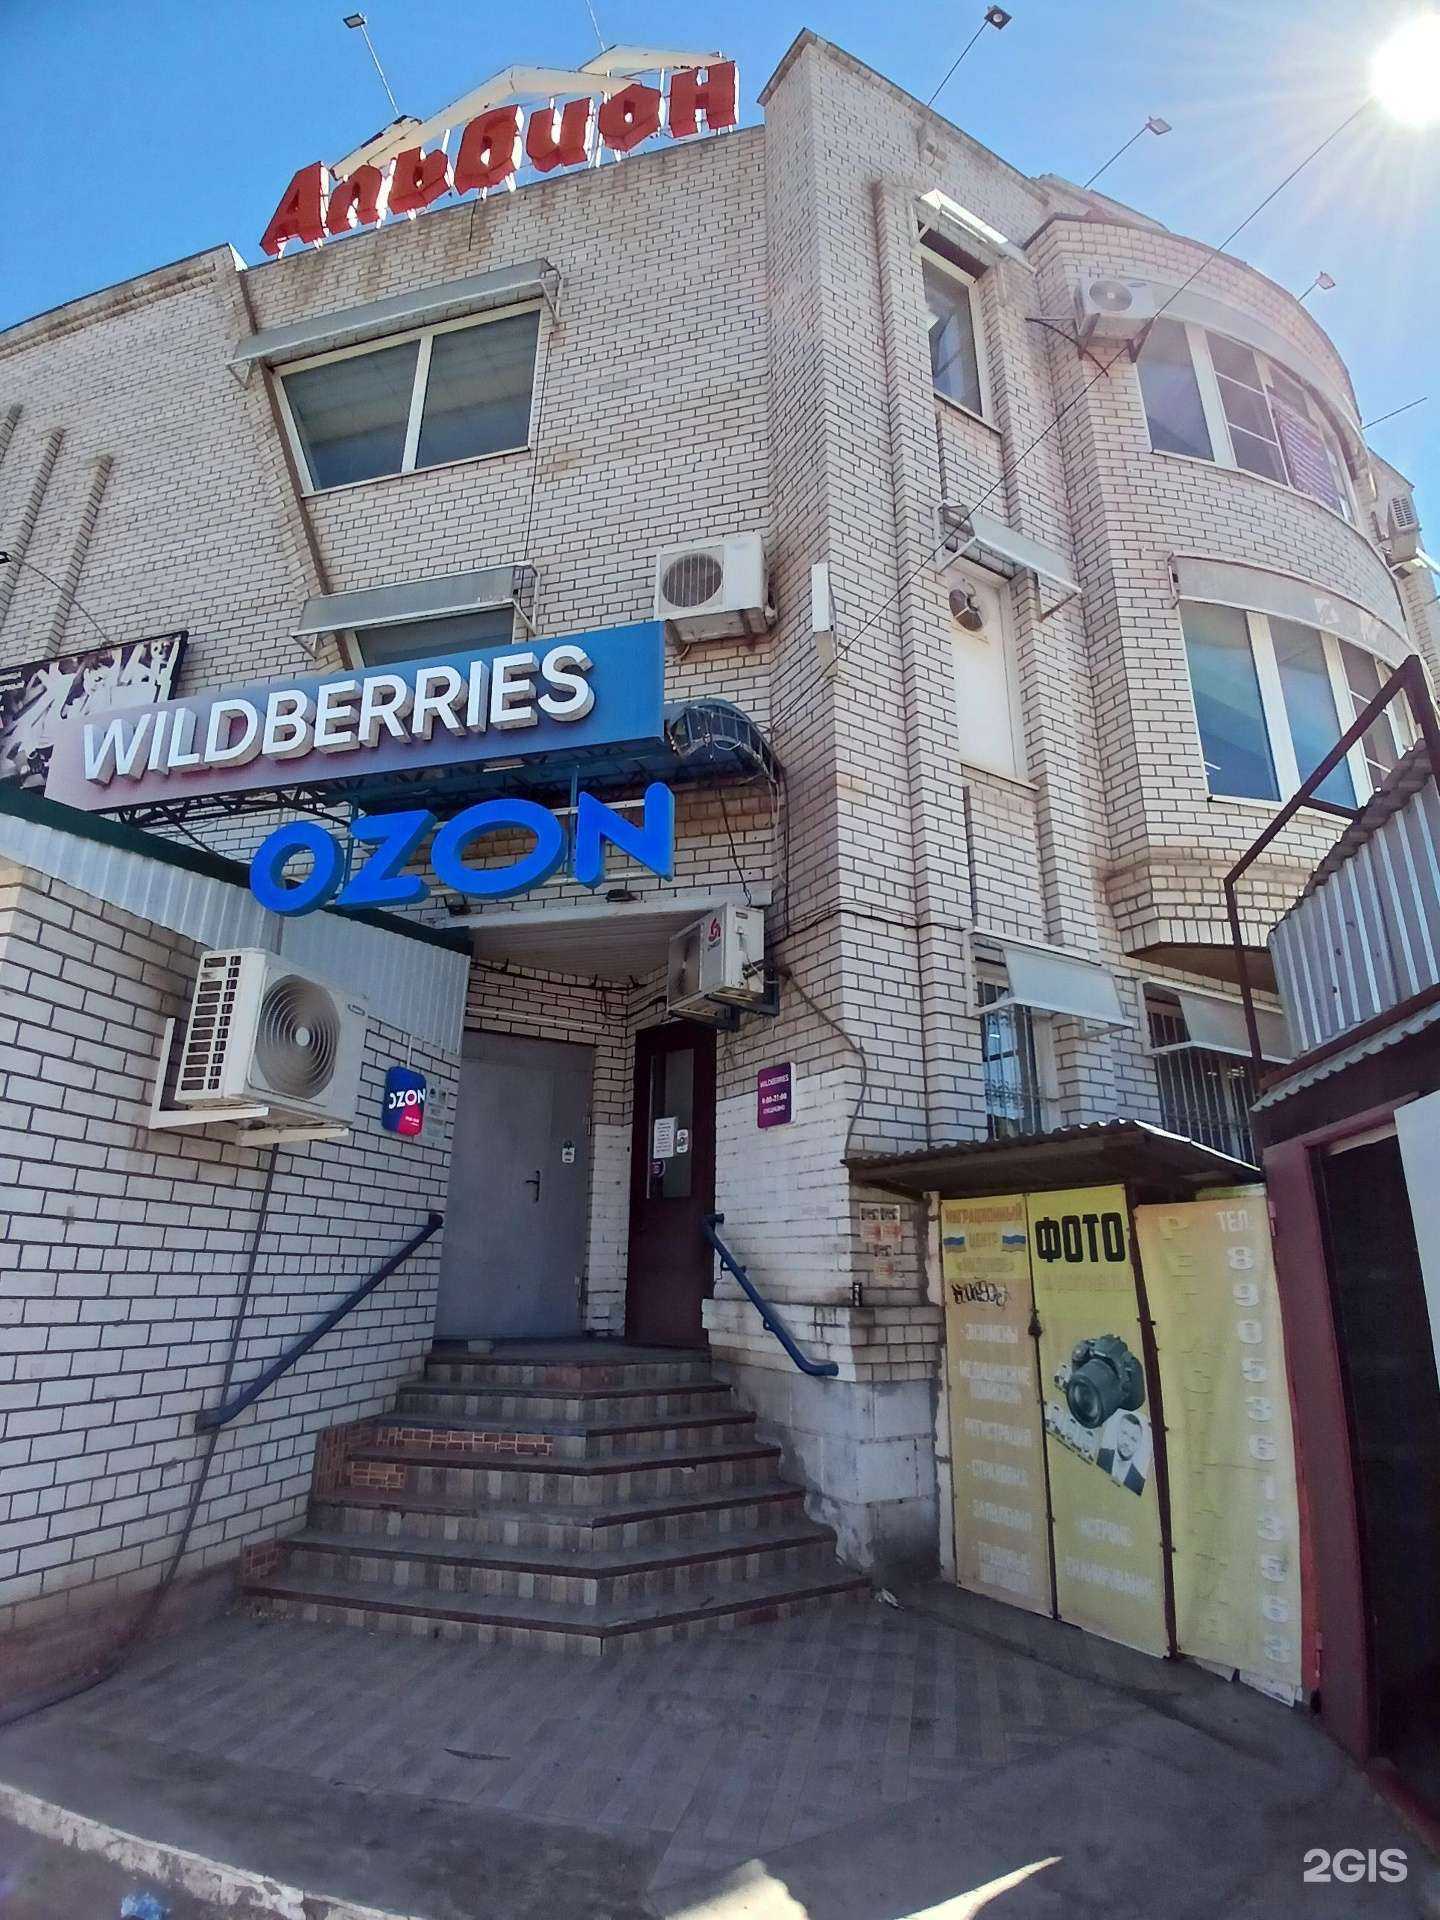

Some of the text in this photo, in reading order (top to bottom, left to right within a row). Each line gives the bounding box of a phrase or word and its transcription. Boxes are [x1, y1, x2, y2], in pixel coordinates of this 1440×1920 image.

[83, 644, 596, 787] WILDBERRIES
[249, 782, 675, 916] OZON
[1035, 1212, 1126, 1263] ФОТО
